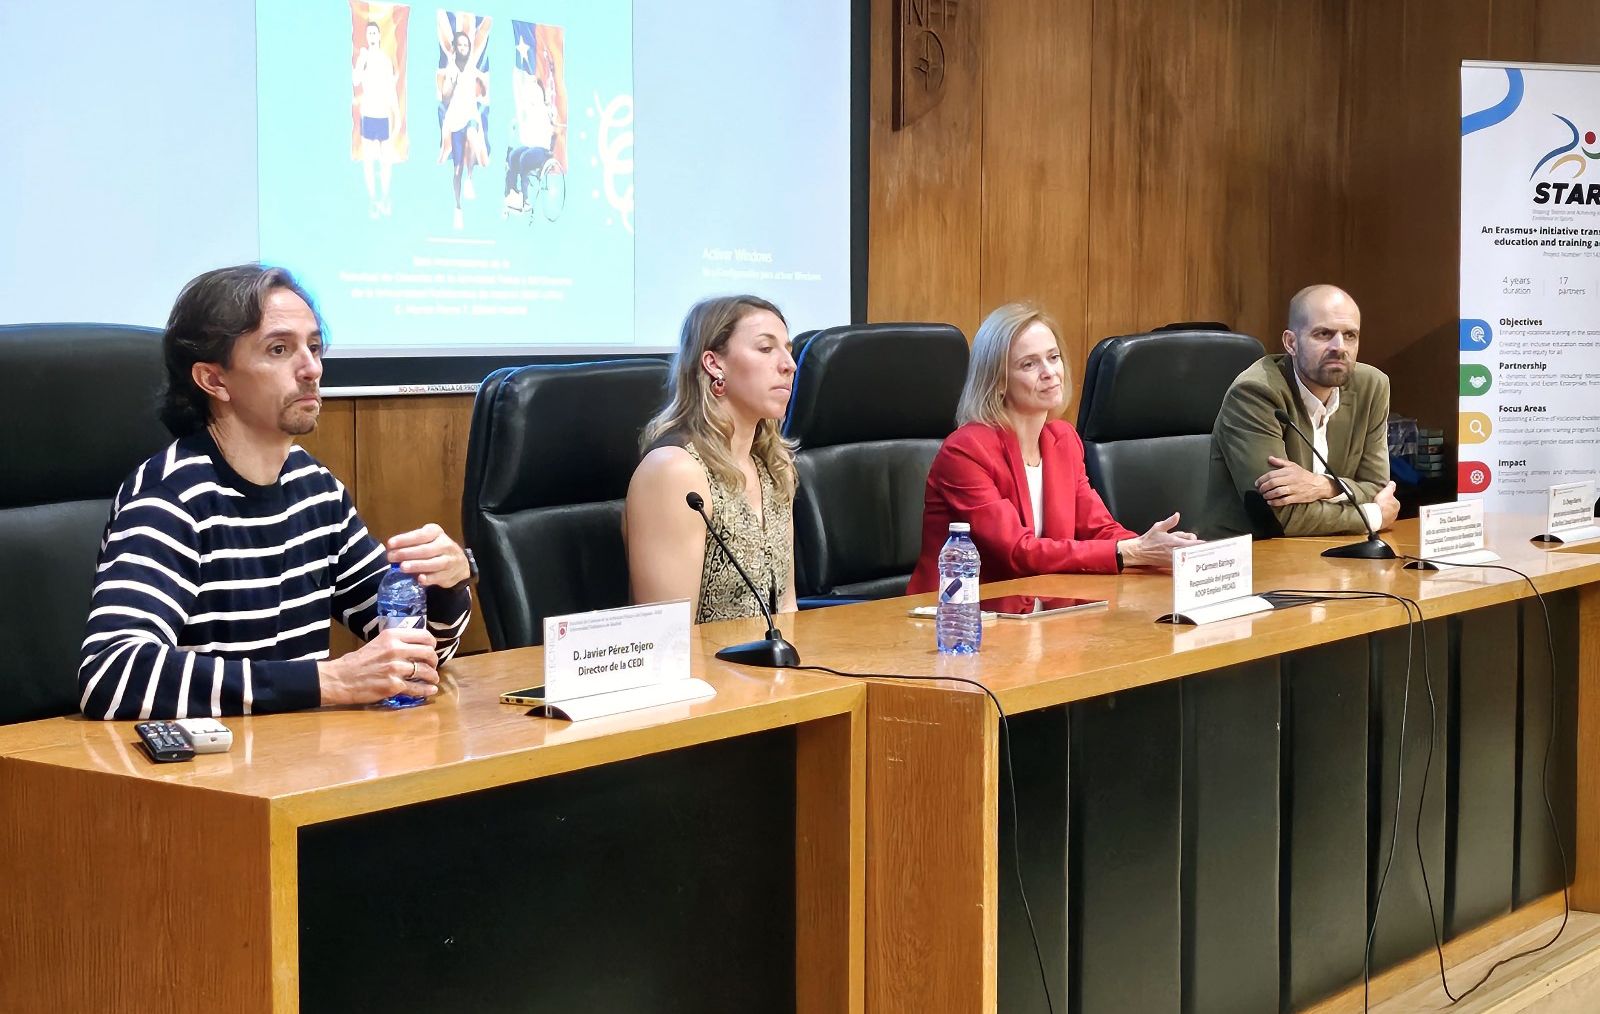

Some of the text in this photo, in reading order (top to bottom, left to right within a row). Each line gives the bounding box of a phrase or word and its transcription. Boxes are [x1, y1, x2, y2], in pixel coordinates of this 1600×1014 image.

[1481, 226, 1493, 234] An
[1496, 226, 1538, 235] Erasmus+
[1539, 226, 1579, 236] initiative
[1494, 238, 1538, 246] education
[1540, 238, 1556, 246] and
[1558, 239, 1592, 249] training
[1502, 276, 1531, 286] 4 years
[1559, 276, 1568, 285] 17
[1502, 287, 1531, 295] duration
[1559, 288, 1586, 296] partners
[1499, 318, 1543, 328] Objectives
[1499, 362, 1547, 371] Partnership
[1498, 459, 1526, 468] Impact
[1201, 562, 1218, 571] Carmen
[1190, 571, 1240, 588] Responsable del programa
[573, 642, 654, 661] D. Javier Pérez Tejero
[578, 657, 645, 676] Director de la CEDI
